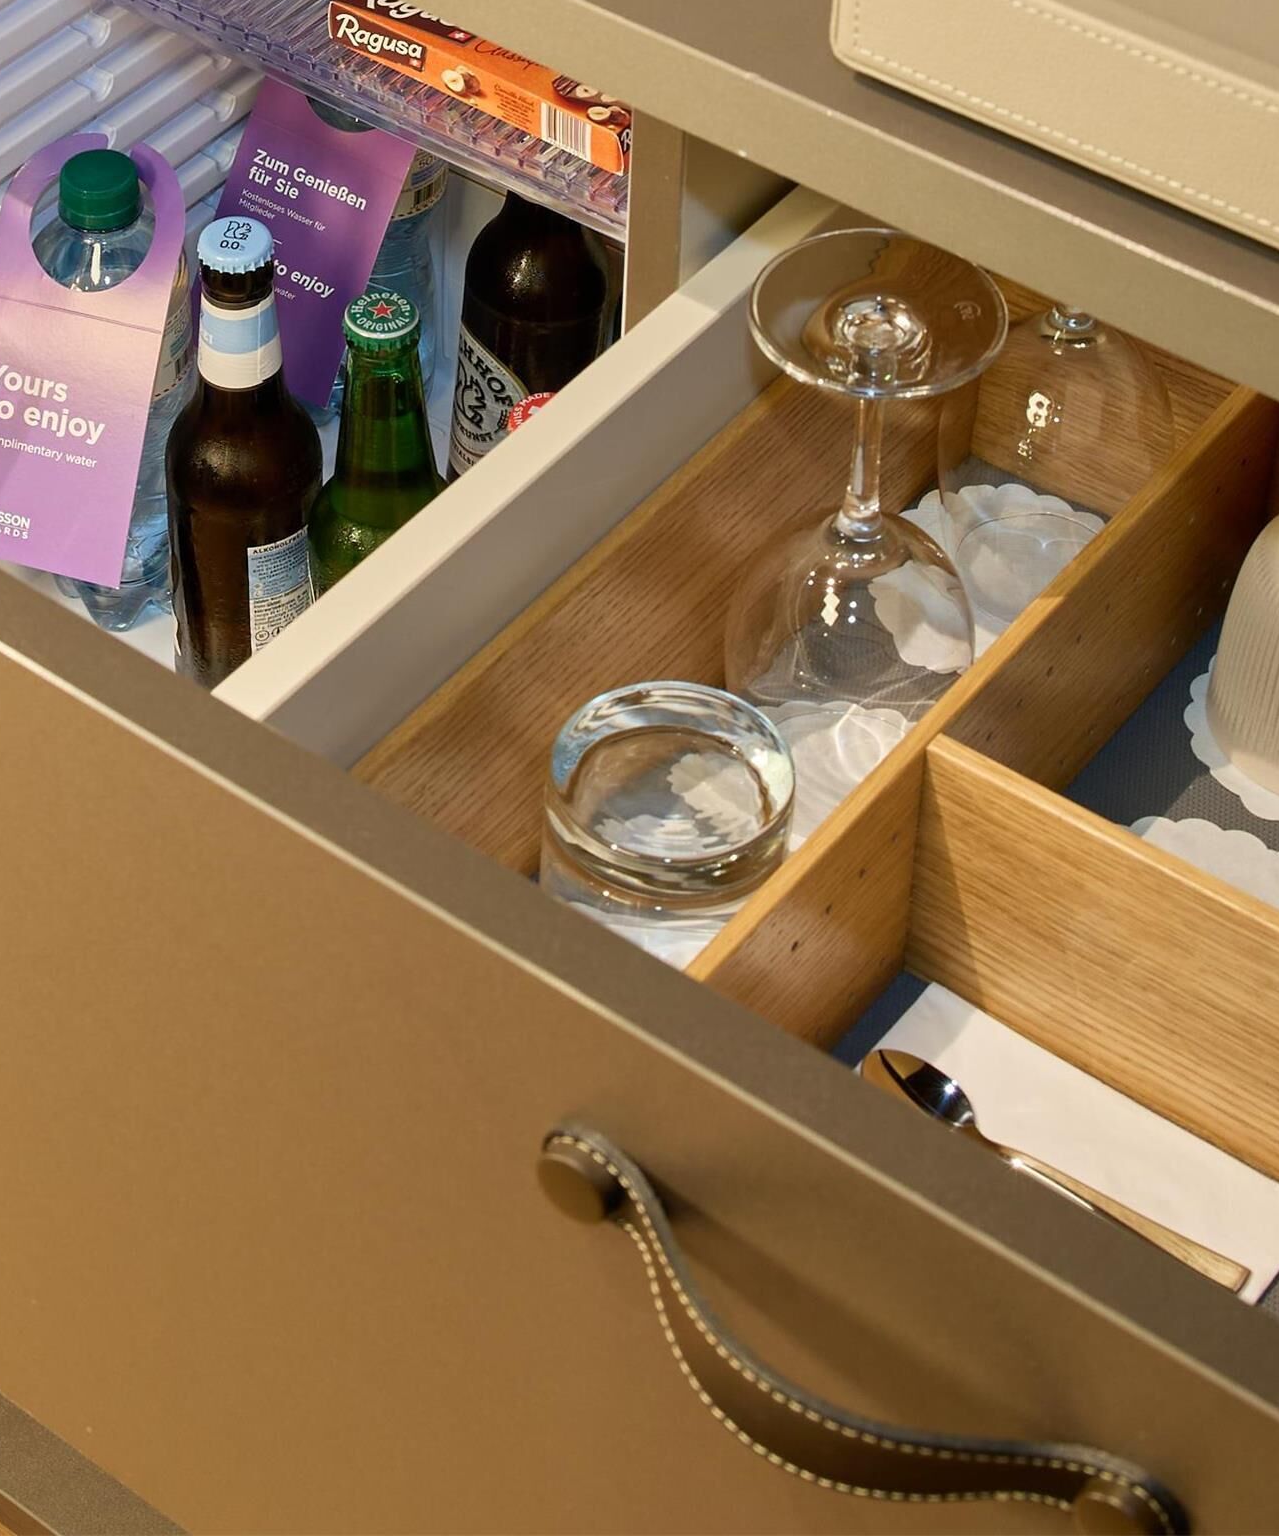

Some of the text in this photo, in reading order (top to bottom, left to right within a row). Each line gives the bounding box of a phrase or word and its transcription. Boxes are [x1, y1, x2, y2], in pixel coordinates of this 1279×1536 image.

[336, 14, 423, 58] Ragusa
[249, 166, 299, 200] für Sie
[253, 149, 367, 210] Zum Genießen
[239, 198, 275, 220] Mitglieder
[241, 188, 326, 232] Kostenloses Wasser für
[291, 270, 335, 298] enjoy
[351, 292, 411, 314] Heineken
[357, 316, 410, 332] ORIGINAL
[23, 406, 106, 446] enjoy
[65, 453, 97, 468] water
